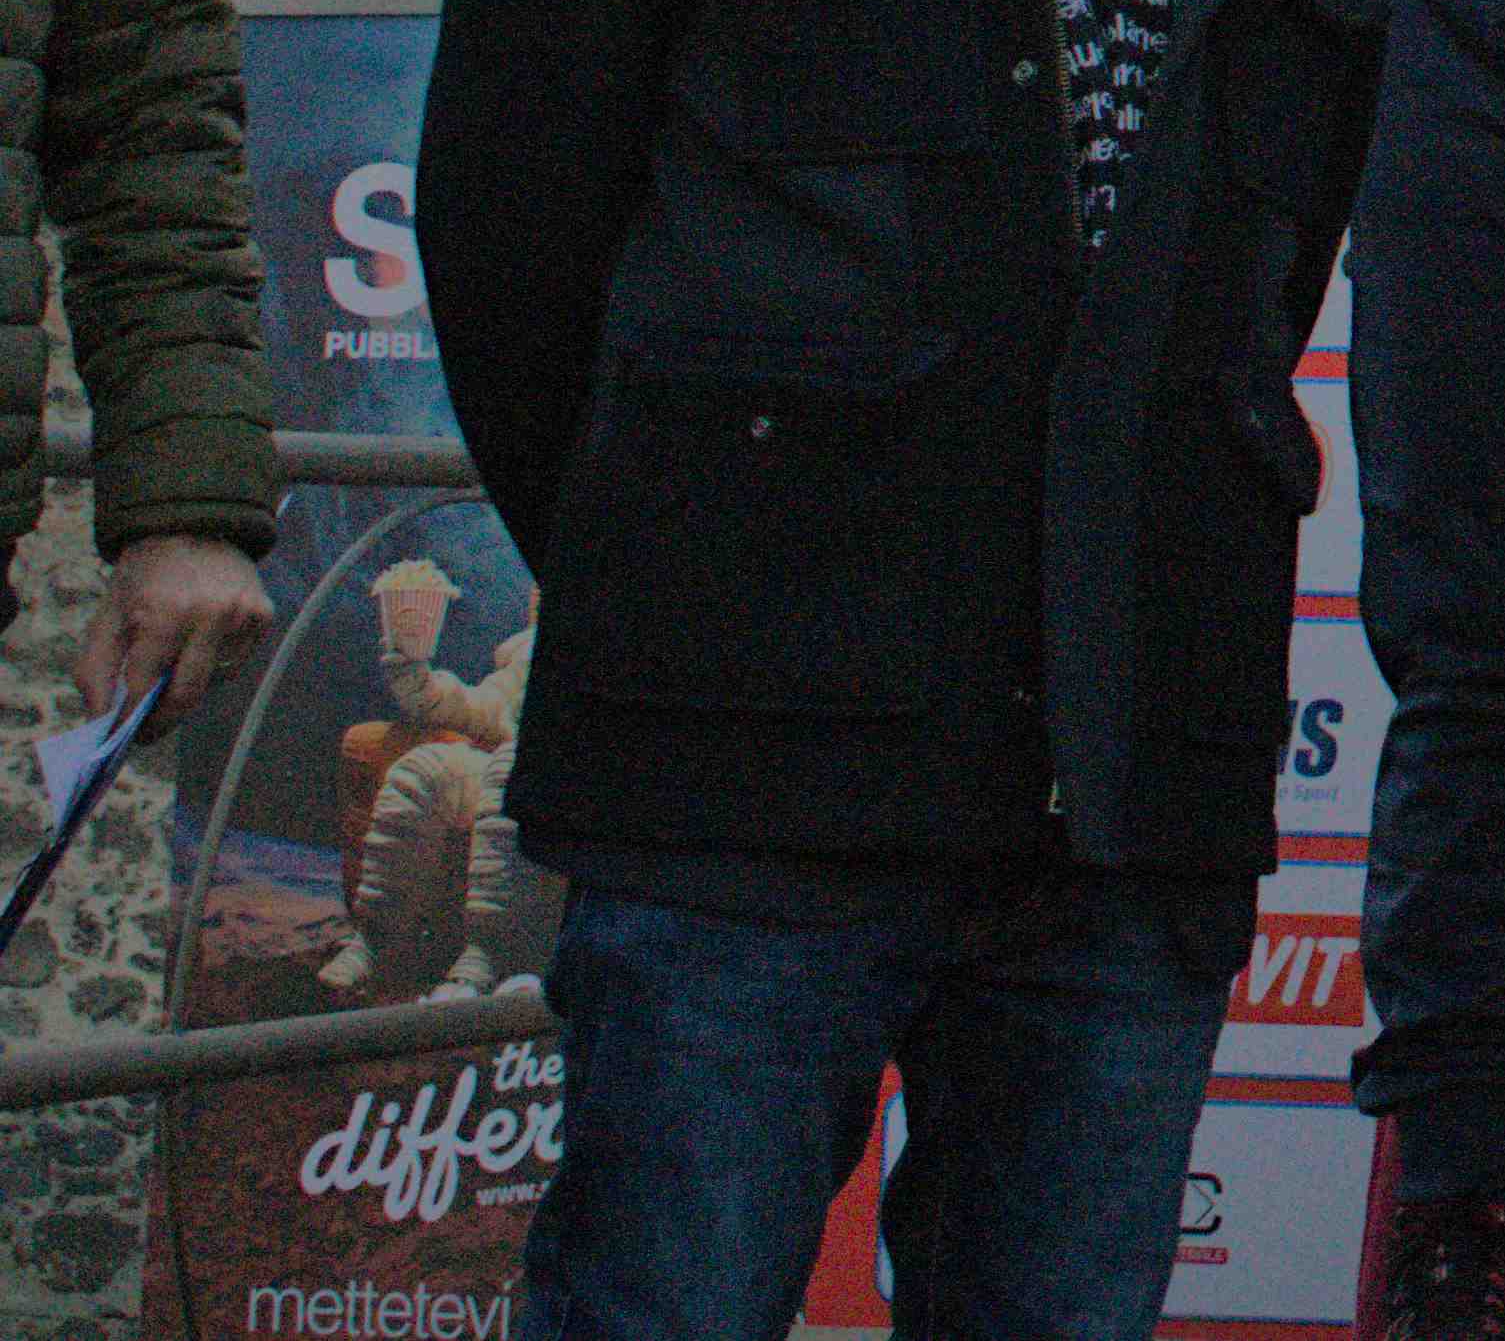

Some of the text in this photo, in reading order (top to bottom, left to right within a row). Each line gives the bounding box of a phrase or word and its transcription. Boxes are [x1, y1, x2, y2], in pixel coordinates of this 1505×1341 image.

[492, 1041, 565, 1092] the
[300, 1066, 564, 1221] differ
[247, 1277, 513, 1340] mettetevi
